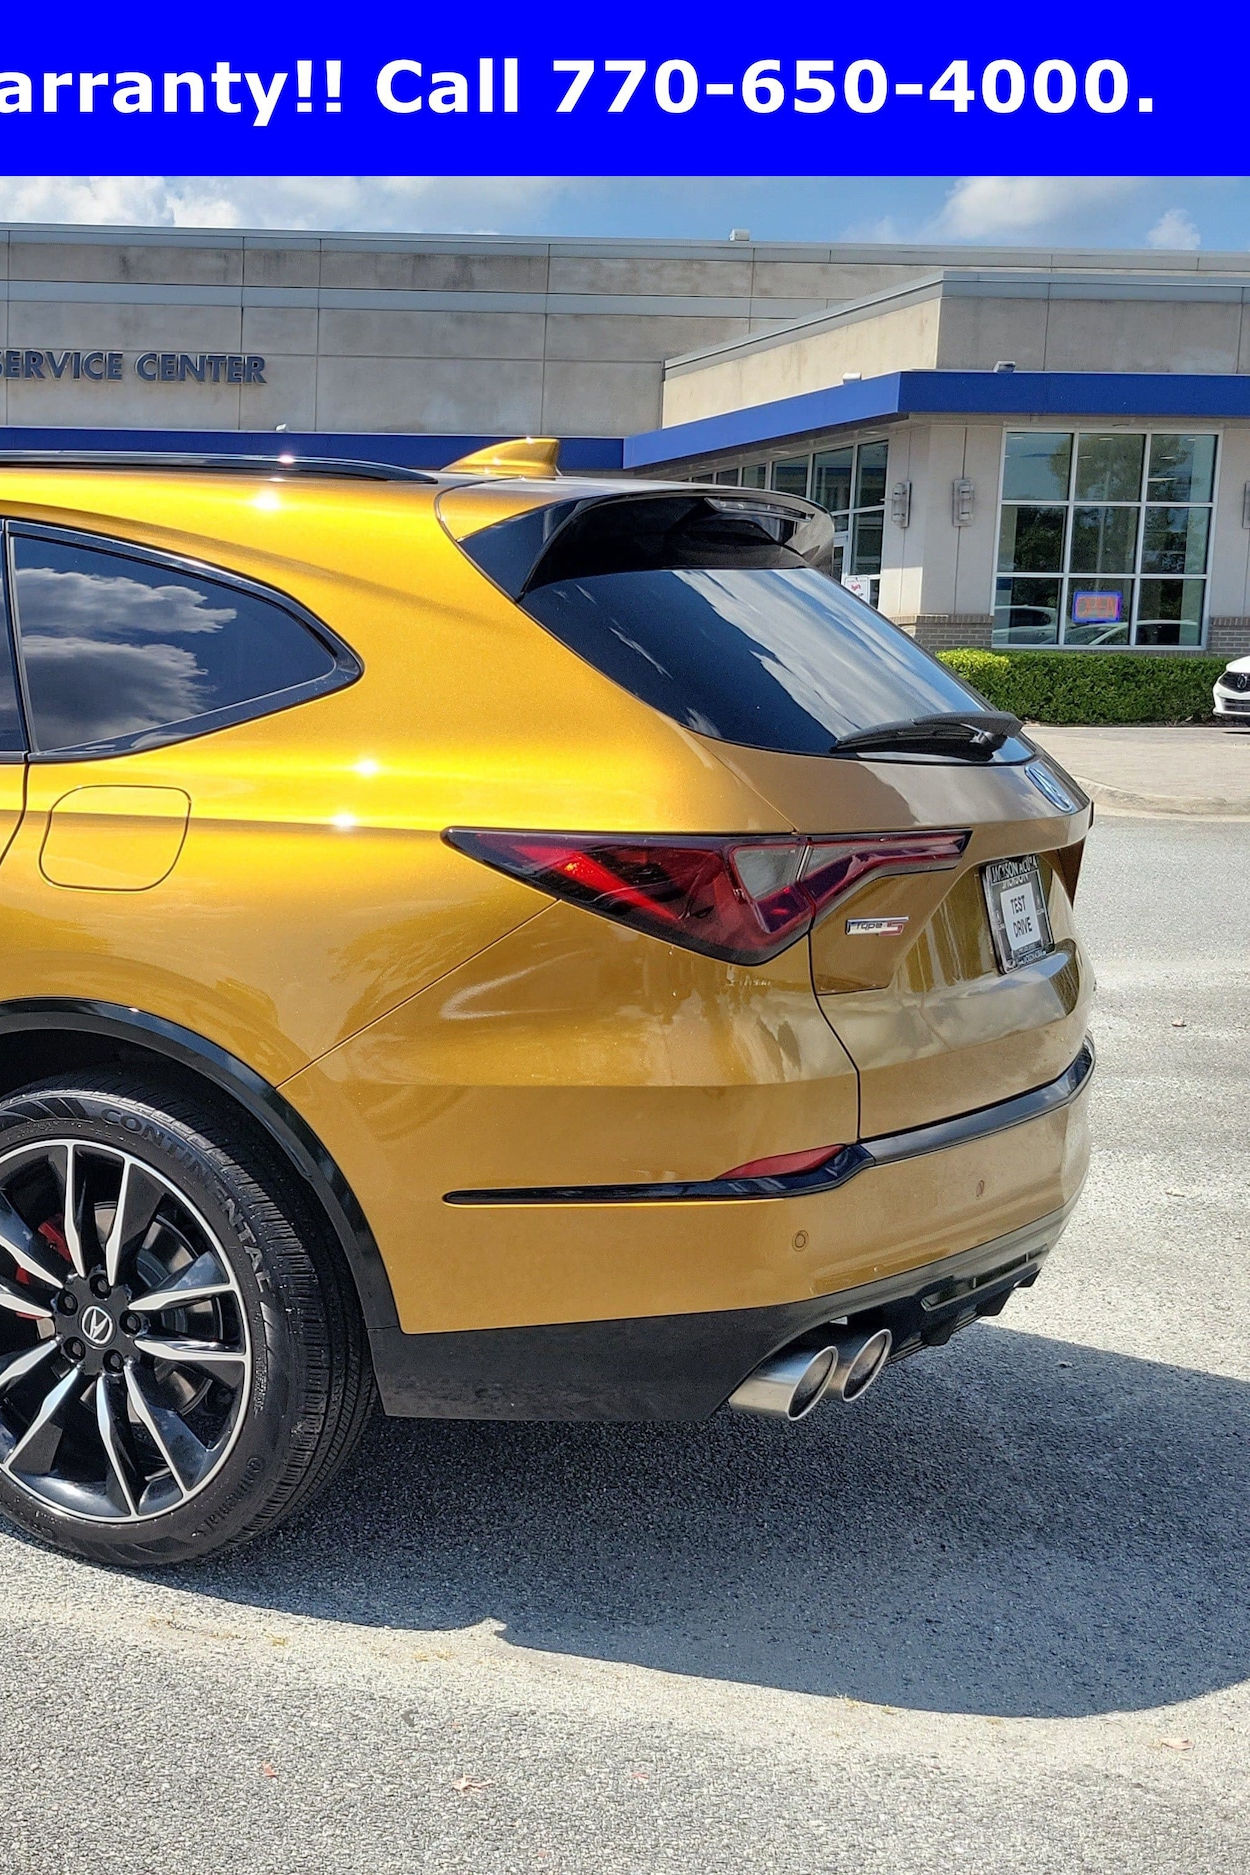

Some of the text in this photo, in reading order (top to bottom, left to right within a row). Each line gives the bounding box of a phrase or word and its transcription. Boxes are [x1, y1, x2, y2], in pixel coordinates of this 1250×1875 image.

[135, 352, 268, 384] CENTER
[1010, 895, 1026, 914] TEST
[1013, 917, 1033, 937] DRIVE
[100, 1108, 272, 1293] CONTINENTAL
